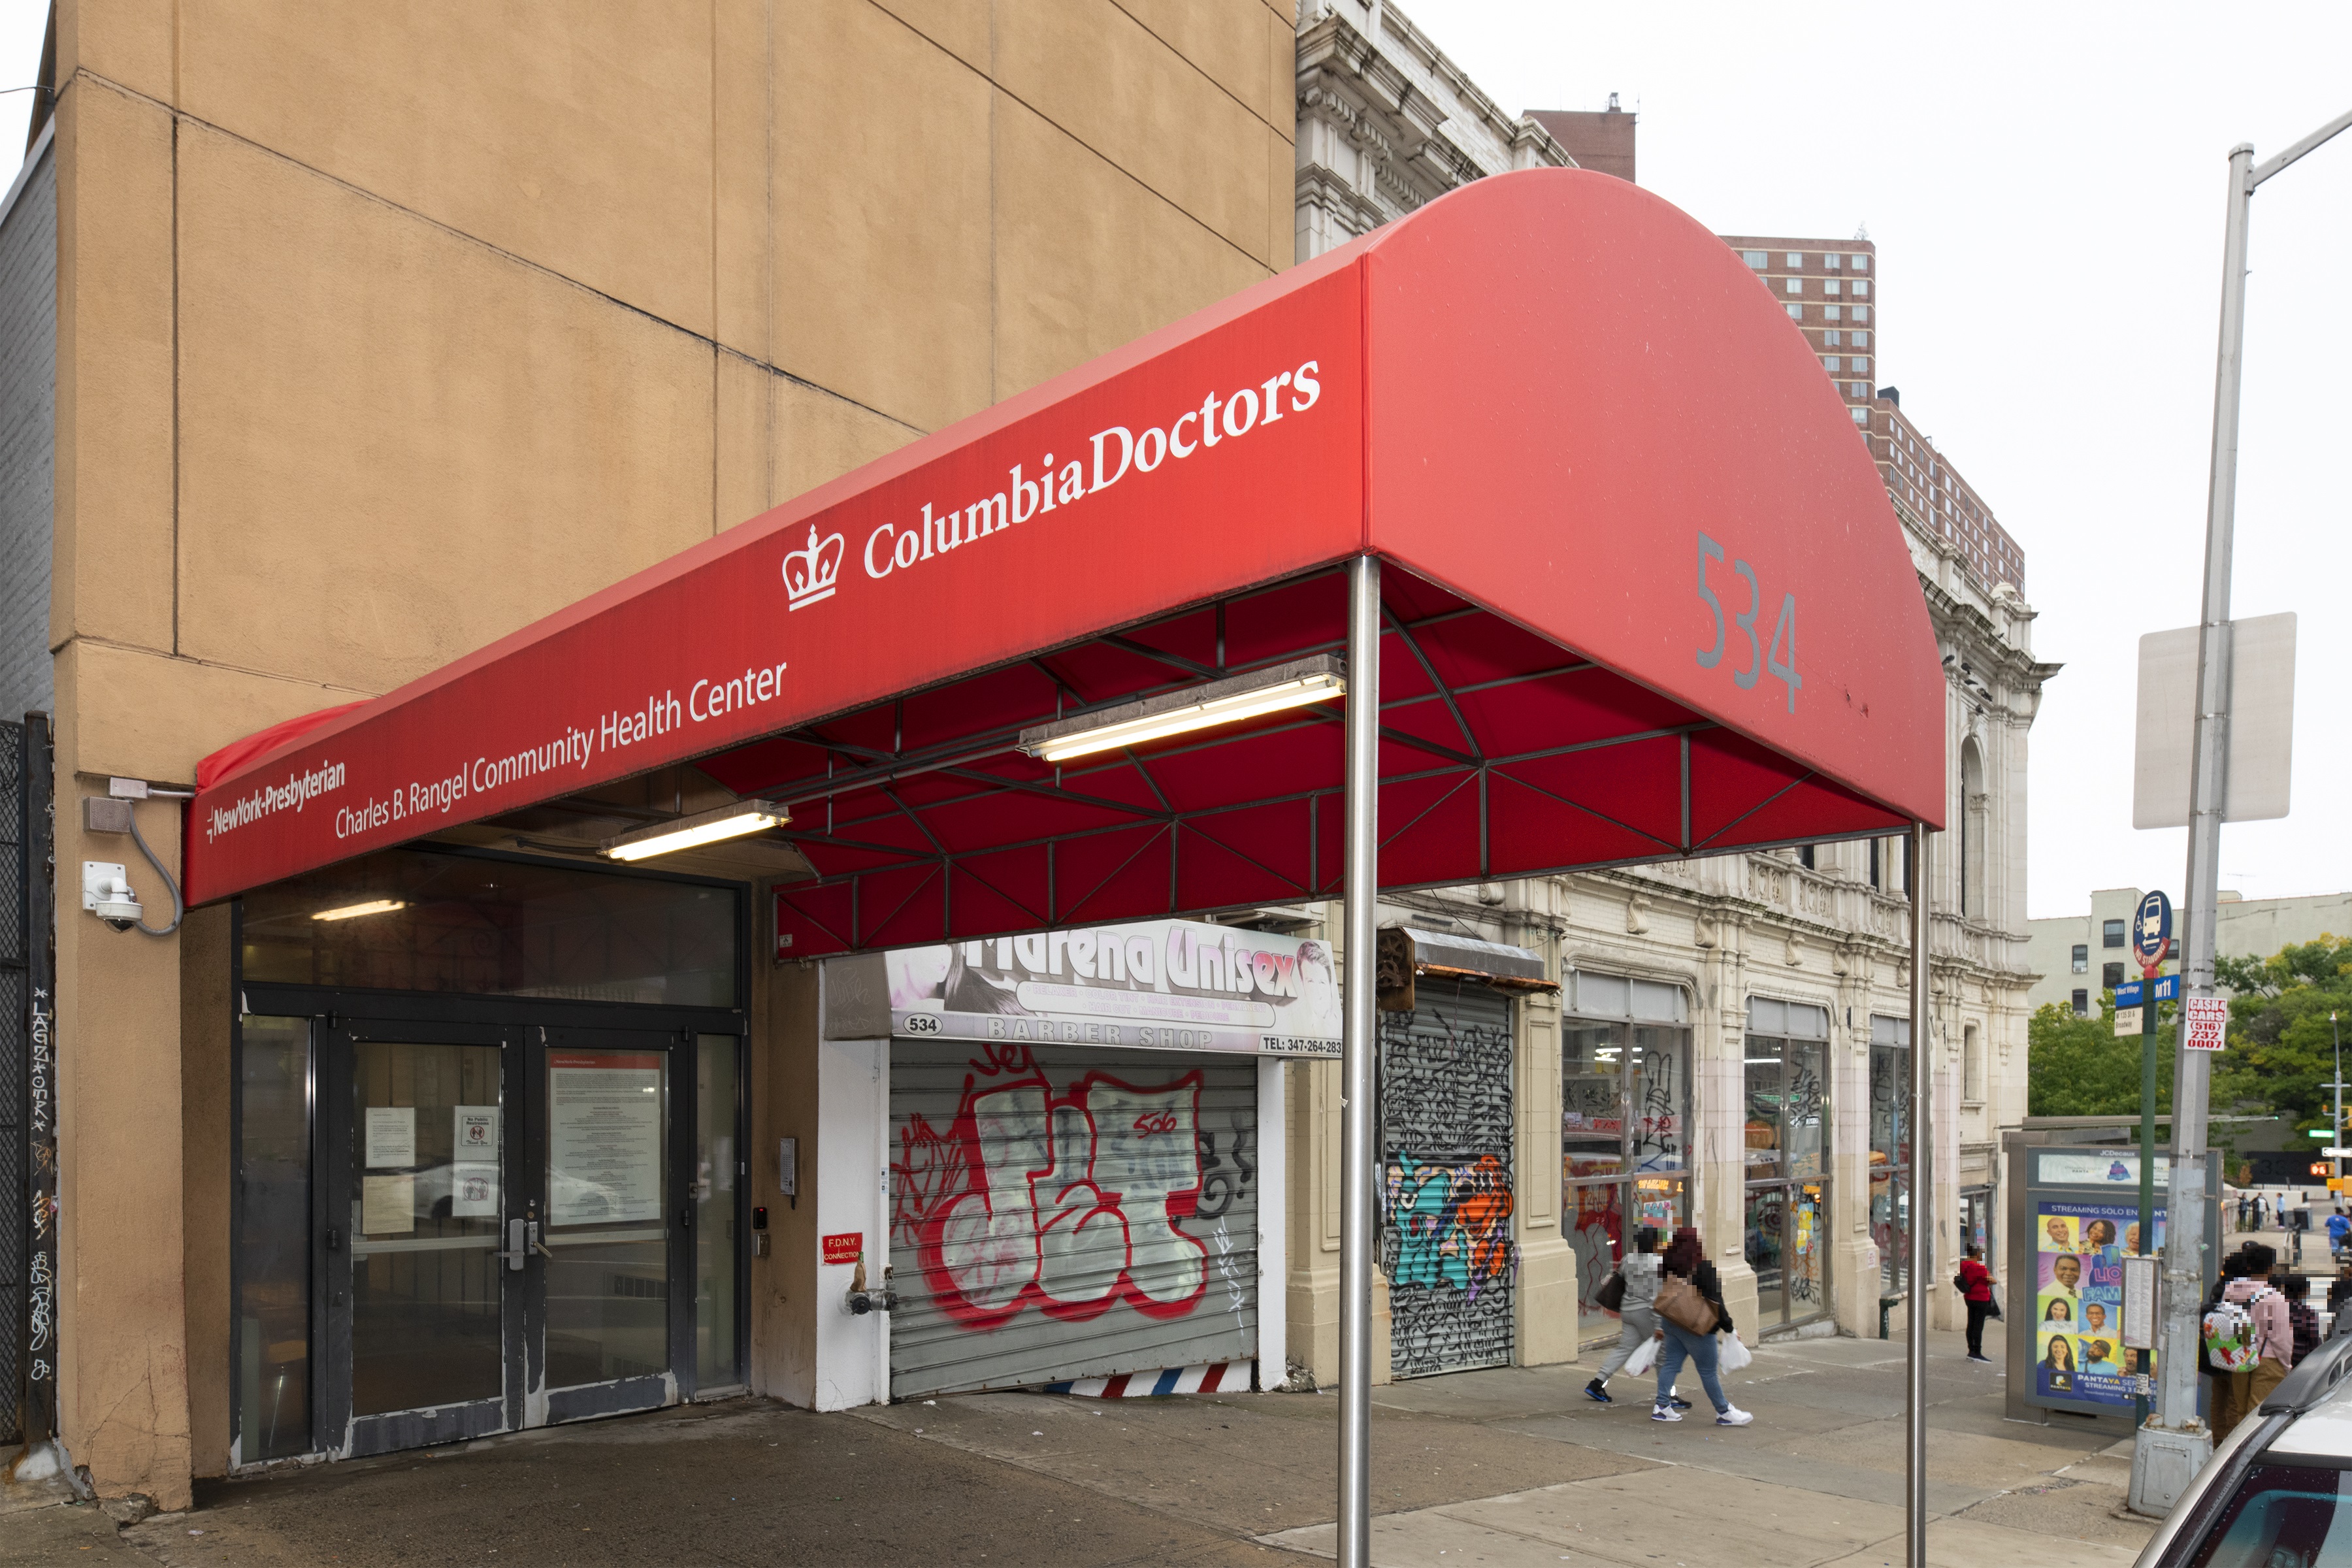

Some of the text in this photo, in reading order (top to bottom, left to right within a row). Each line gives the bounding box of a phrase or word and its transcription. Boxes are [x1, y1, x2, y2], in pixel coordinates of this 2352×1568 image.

[864, 361, 1321, 579] ColumbiaDoctors
[1697, 530, 1802, 715] 534
[336, 662, 787, 838] Charles B. Rangel Community Health Center
[214, 759, 345, 836] NewYork-Presbyterian
[1166, 925, 1298, 998] Unisex
[2135, 942, 2165, 965] NO STANDING
[2127, 985, 2139, 994] Village
[2155, 979, 2171, 998] M11
[1033, 984, 1266, 1013] RELAXER COLOR TINT HAIR EXTENSION PERMANENT
[1089, 1002, 1230, 1021] HAIR CUT MANICURE PEDICURE
[2189, 1010, 2224, 1021] CARS
[909, 1018, 937, 1032] 534
[987, 1017, 1213, 1049] BARBER SHOP
[2190, 1021, 2221, 1031] (516)
[2191, 1031, 2219, 1039] 232
[1264, 1037, 1343, 1054] TEL: 347-264-283
[2187, 1039, 2221, 1049] 0007
[2051, 1205, 2099, 1215] STREAMING
[828, 1237, 857, 1247] F.D.N.Y.
[2094, 1266, 2121, 1282] LIO
[2078, 1374, 2120, 1384] PANTAYA
[2085, 1382, 2126, 1392] STREAMING
